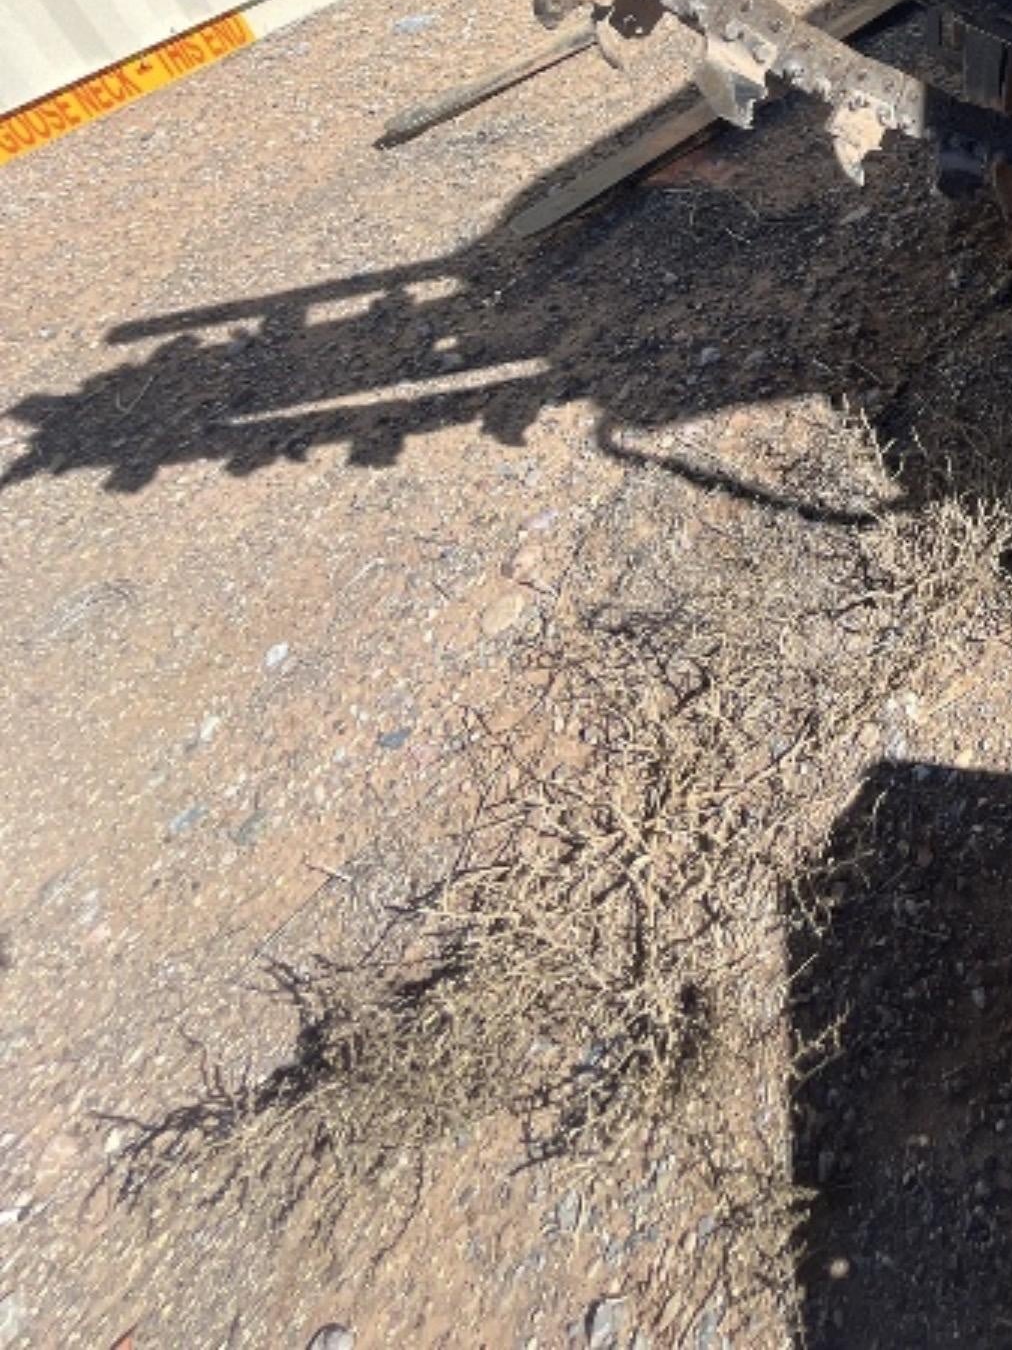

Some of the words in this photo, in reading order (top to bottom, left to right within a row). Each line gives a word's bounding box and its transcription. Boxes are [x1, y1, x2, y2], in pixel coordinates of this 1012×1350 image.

[72, 66, 142, 119] NECK
[156, 36, 205, 78] THIS
[200, 16, 248, 57] END
